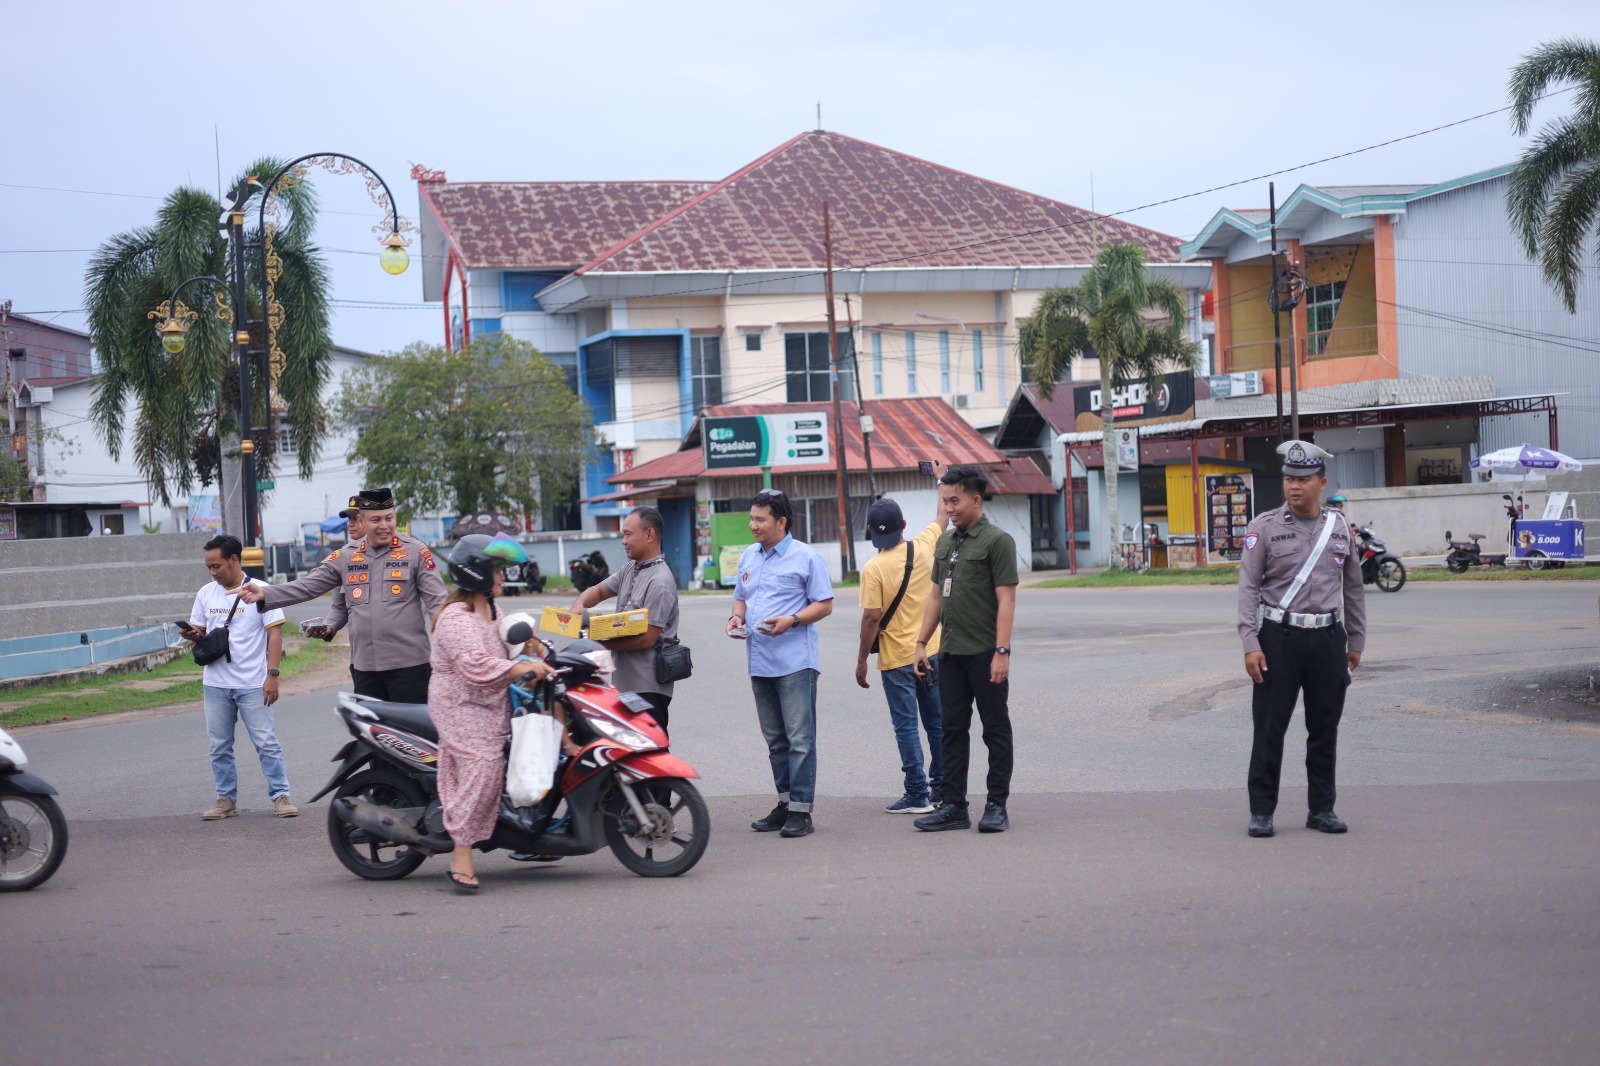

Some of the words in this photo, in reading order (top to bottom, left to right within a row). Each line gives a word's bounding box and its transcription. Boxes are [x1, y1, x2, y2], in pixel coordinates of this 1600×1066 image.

[710, 440, 757, 454] Pegadaian
[1271, 532, 1297, 543] ANWAR
[1537, 536, 1561, 544] 8.000
